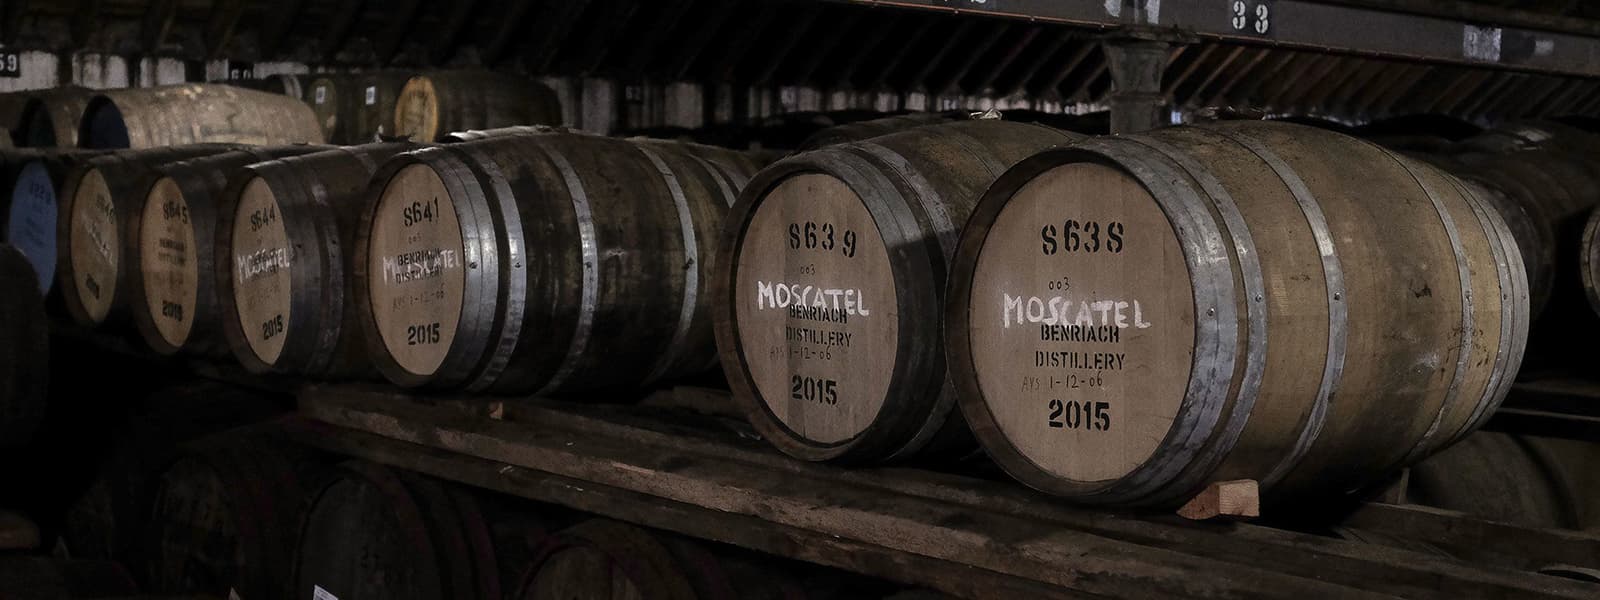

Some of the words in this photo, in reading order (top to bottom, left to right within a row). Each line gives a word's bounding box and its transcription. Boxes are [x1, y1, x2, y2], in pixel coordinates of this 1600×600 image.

[1048, 276, 1070, 291] 003
[757, 280, 870, 317] MOSCATEL
[789, 304, 848, 324] BENRIACH
[1003, 292, 1152, 329] MOSCATEL
[408, 323, 441, 345] 2015
[785, 326, 852, 347] DISTILLERY
[1040, 324, 1120, 343] BENRIACH
[1035, 351, 1126, 371] DISTILLERY
[792, 374, 838, 406] 2015
[1048, 399, 1111, 432] 2015
